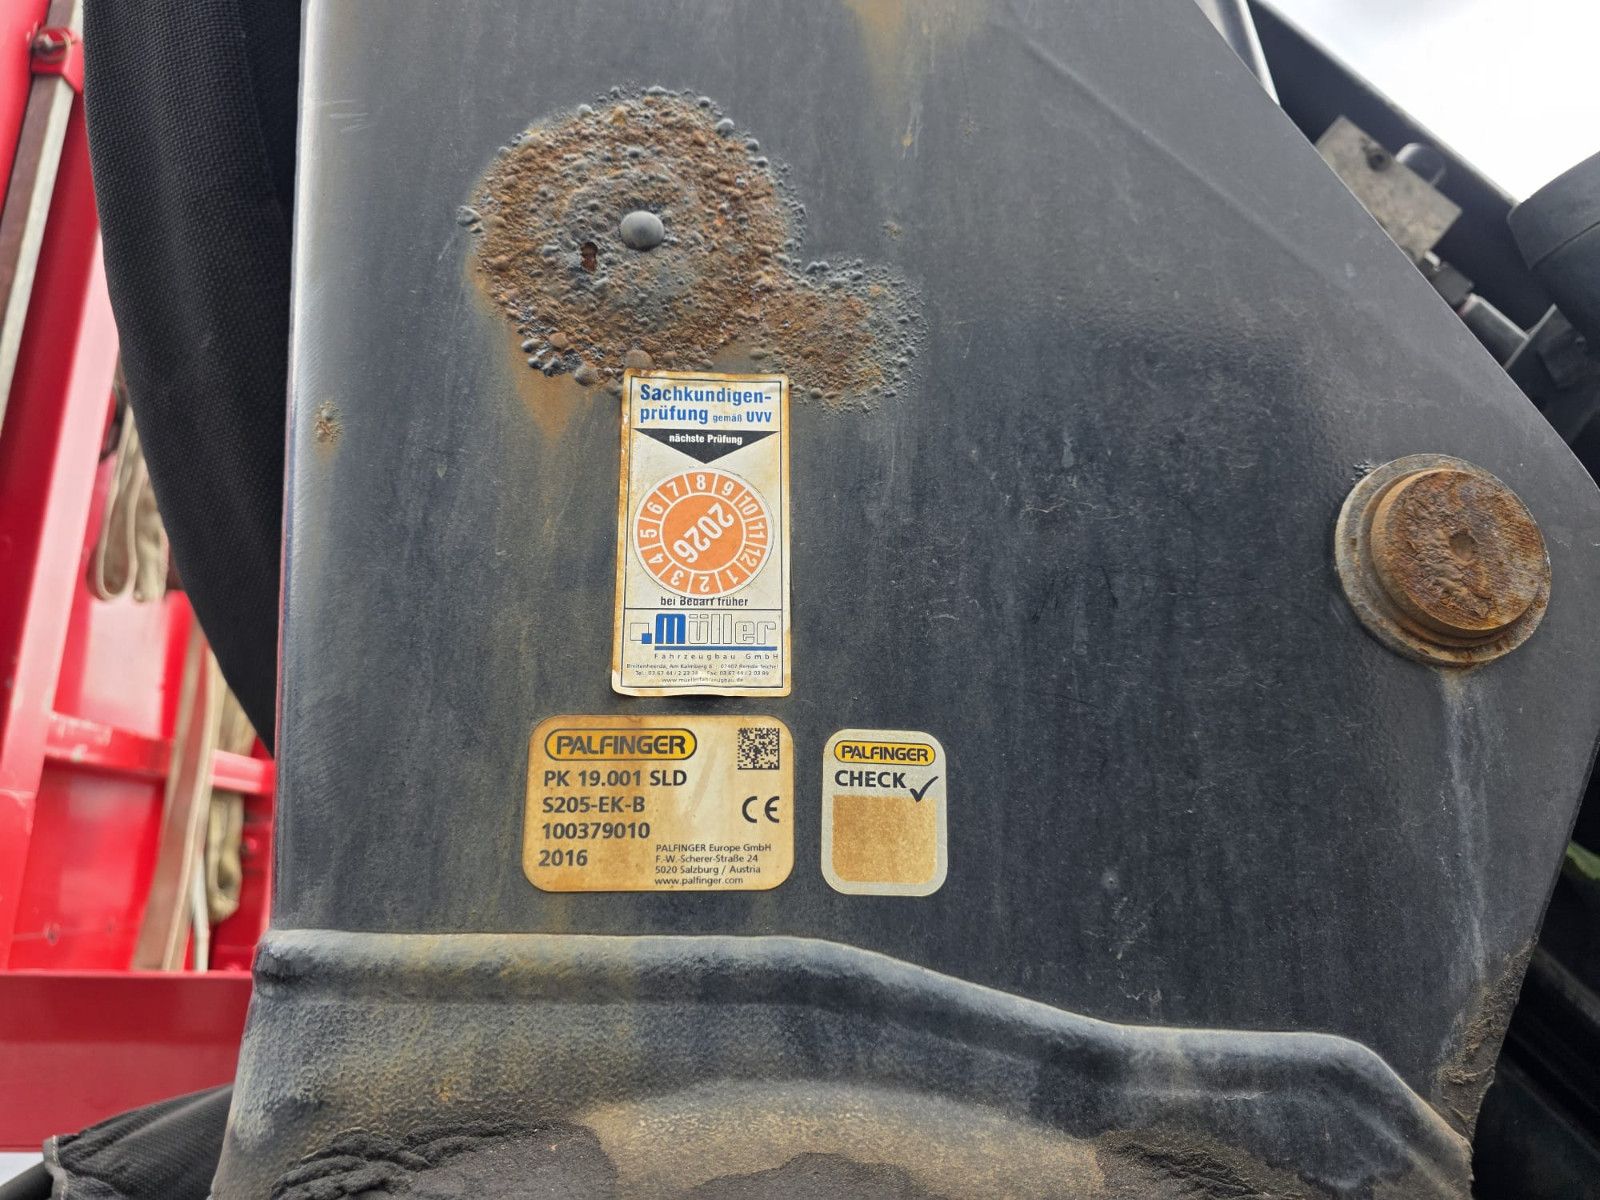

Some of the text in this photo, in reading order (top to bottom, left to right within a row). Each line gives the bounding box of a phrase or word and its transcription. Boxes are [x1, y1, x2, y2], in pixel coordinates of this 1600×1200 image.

[640, 384, 772, 406] Sachkundigen-
[640, 405, 772, 425] prüfung gemäß UVV
[669, 433, 743, 445] nächste Prüfung
[666, 481, 680, 498] 7
[696, 474, 706, 491] 8
[721, 480, 735, 496] 9
[646, 502, 664, 515] 6
[738, 496, 759, 516] 10
[639, 528, 658, 539] 5
[672, 502, 735, 564] 2026
[749, 521, 767, 539] 11
[648, 552, 664, 565] 4
[740, 549, 762, 568] 12
[670, 569, 685, 586] 3
[700, 576, 710, 593] 2
[726, 569, 740, 585] 1
[660, 596, 676, 606] bei
[717, 596, 748, 607] früher
[655, 613, 777, 645] Müller
[654, 653, 736, 661] Fahrzeugbau
[556, 735, 686, 755] PALFINGER
[841, 745, 929, 762] PALFINGER
[544, 769, 688, 787] PK 19.001 SLD
[834, 769, 907, 789] CHECK
[542, 796, 646, 813] S205-EK-B
[541, 822, 651, 840] 100379010
[656, 843, 772, 853] PALFINGER Europe GmbH
[538, 849, 588, 867] 2016
[746, 854, 758, 863] 24
[655, 865, 761, 875] 5020 Salzburg / Austria
[654, 876, 744, 887] www.palfinger.com
